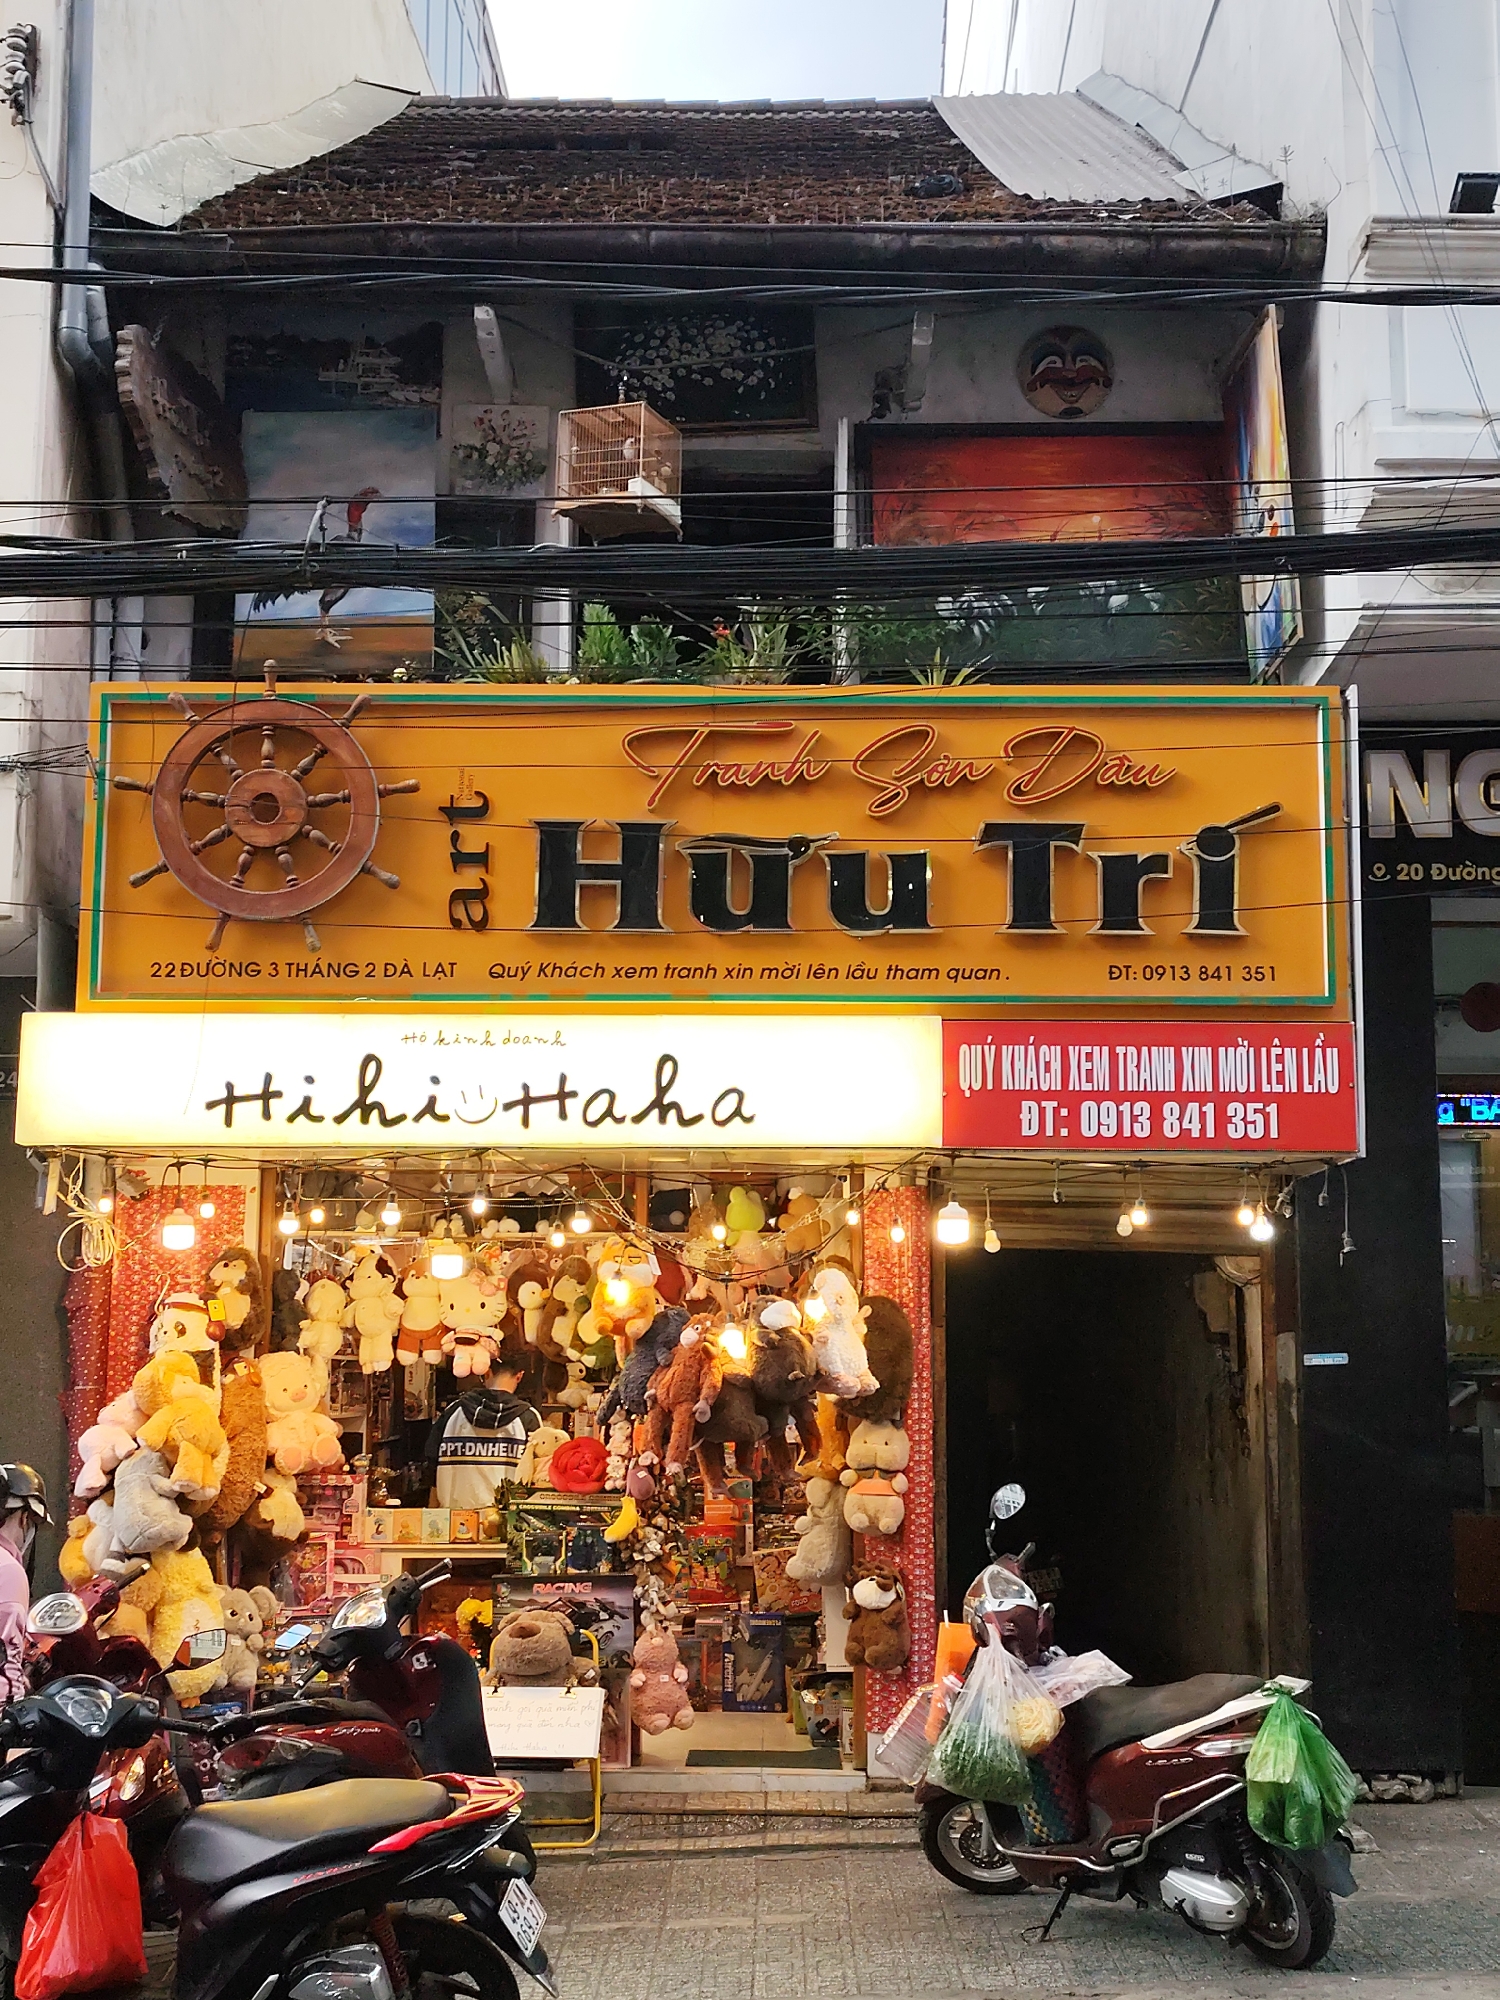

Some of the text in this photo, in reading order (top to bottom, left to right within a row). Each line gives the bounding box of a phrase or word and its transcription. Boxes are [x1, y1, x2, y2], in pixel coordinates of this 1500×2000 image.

[621, 721, 1178, 820] Tranh Sơn Dầu
[438, 789, 491, 933] art
[1397, 860, 1500, 887] 20 Đường
[526, 818, 943, 939] Hữu
[149, 956, 458, 981] 22 ĐƯỜNG 3 THÁNG 2 ĐÀ LẠT
[488, 960, 533, 982] Quý
[536, 960, 606, 979] Khách
[610, 963, 659, 979] xem
[663, 963, 718, 980] tranh
[723, 963, 754, 980] xin
[758, 961, 802, 980] mời
[806, 962, 839, 980] lên
[844, 960, 878, 981] lầu
[885, 963, 941, 981] tham
[1107, 964, 1277, 982] ĐT: 0913 841 351
[502, 1029, 567, 1047] doanh
[958, 1032, 1340, 1098] QUÝ KHÁCH XEM TRANH XIN MỜI LÊN LẦU
[205, 1052, 757, 1130] Hihi Haha
[1020, 1100, 1280, 1140] ĐT: 0913 841 351
[532, 1582, 593, 1595] RACING
